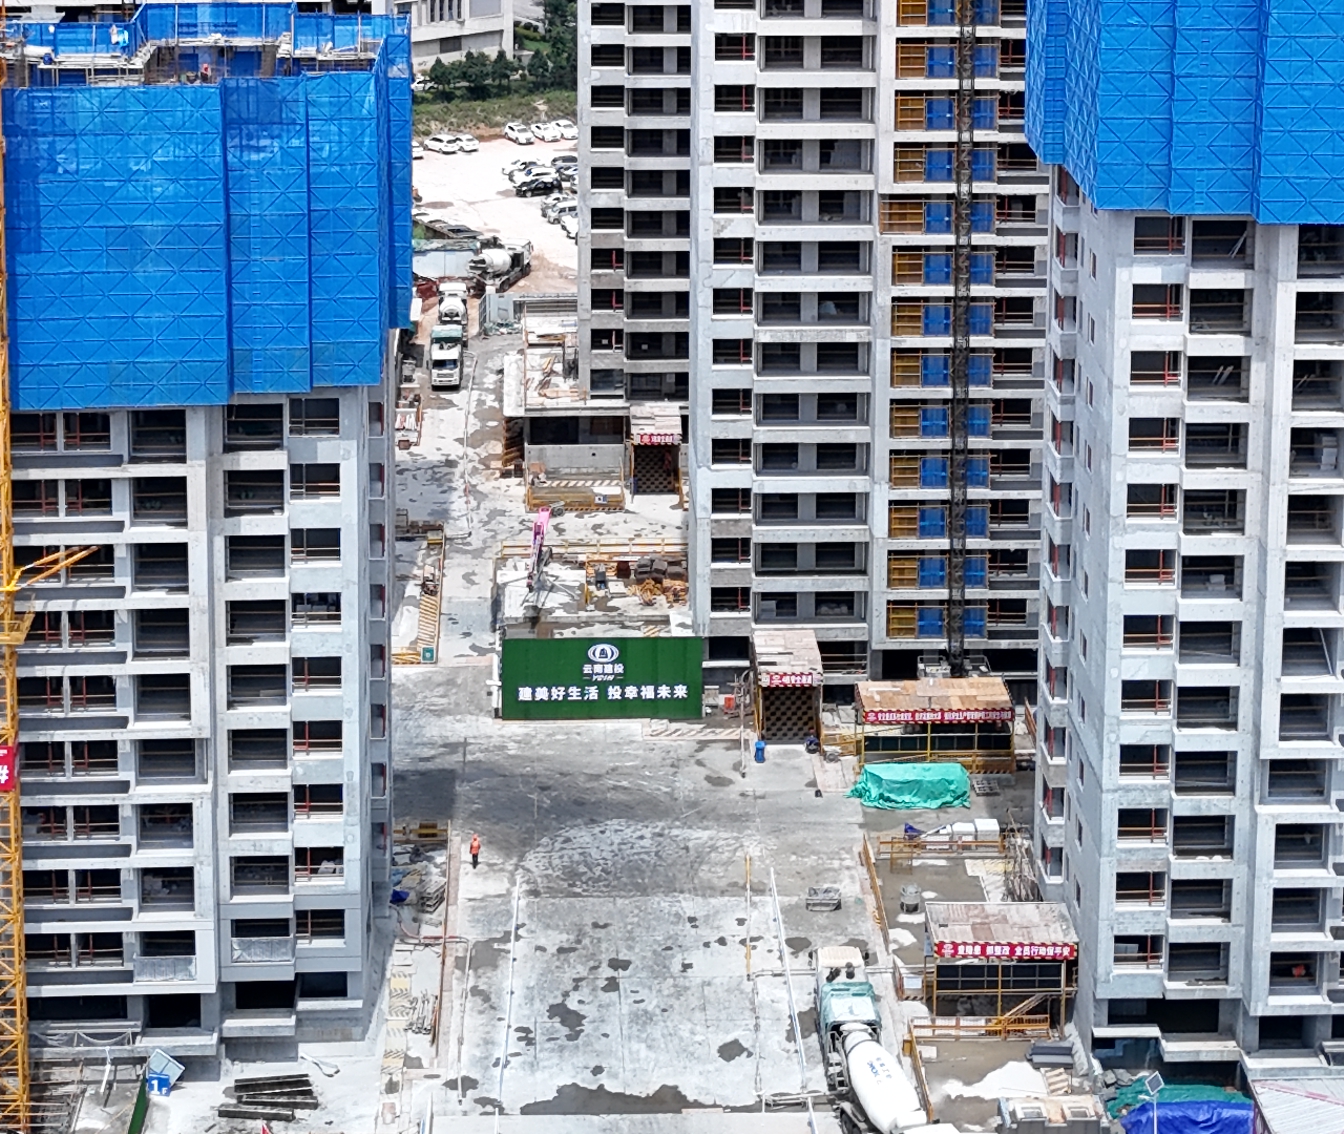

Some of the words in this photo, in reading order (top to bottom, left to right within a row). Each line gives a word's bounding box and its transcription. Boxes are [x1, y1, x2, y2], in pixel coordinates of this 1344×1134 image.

[582, 663, 625, 674] 云南建投
[517, 686, 599, 702] 建美好生活
[607, 684, 689, 701] 投幸福未来
